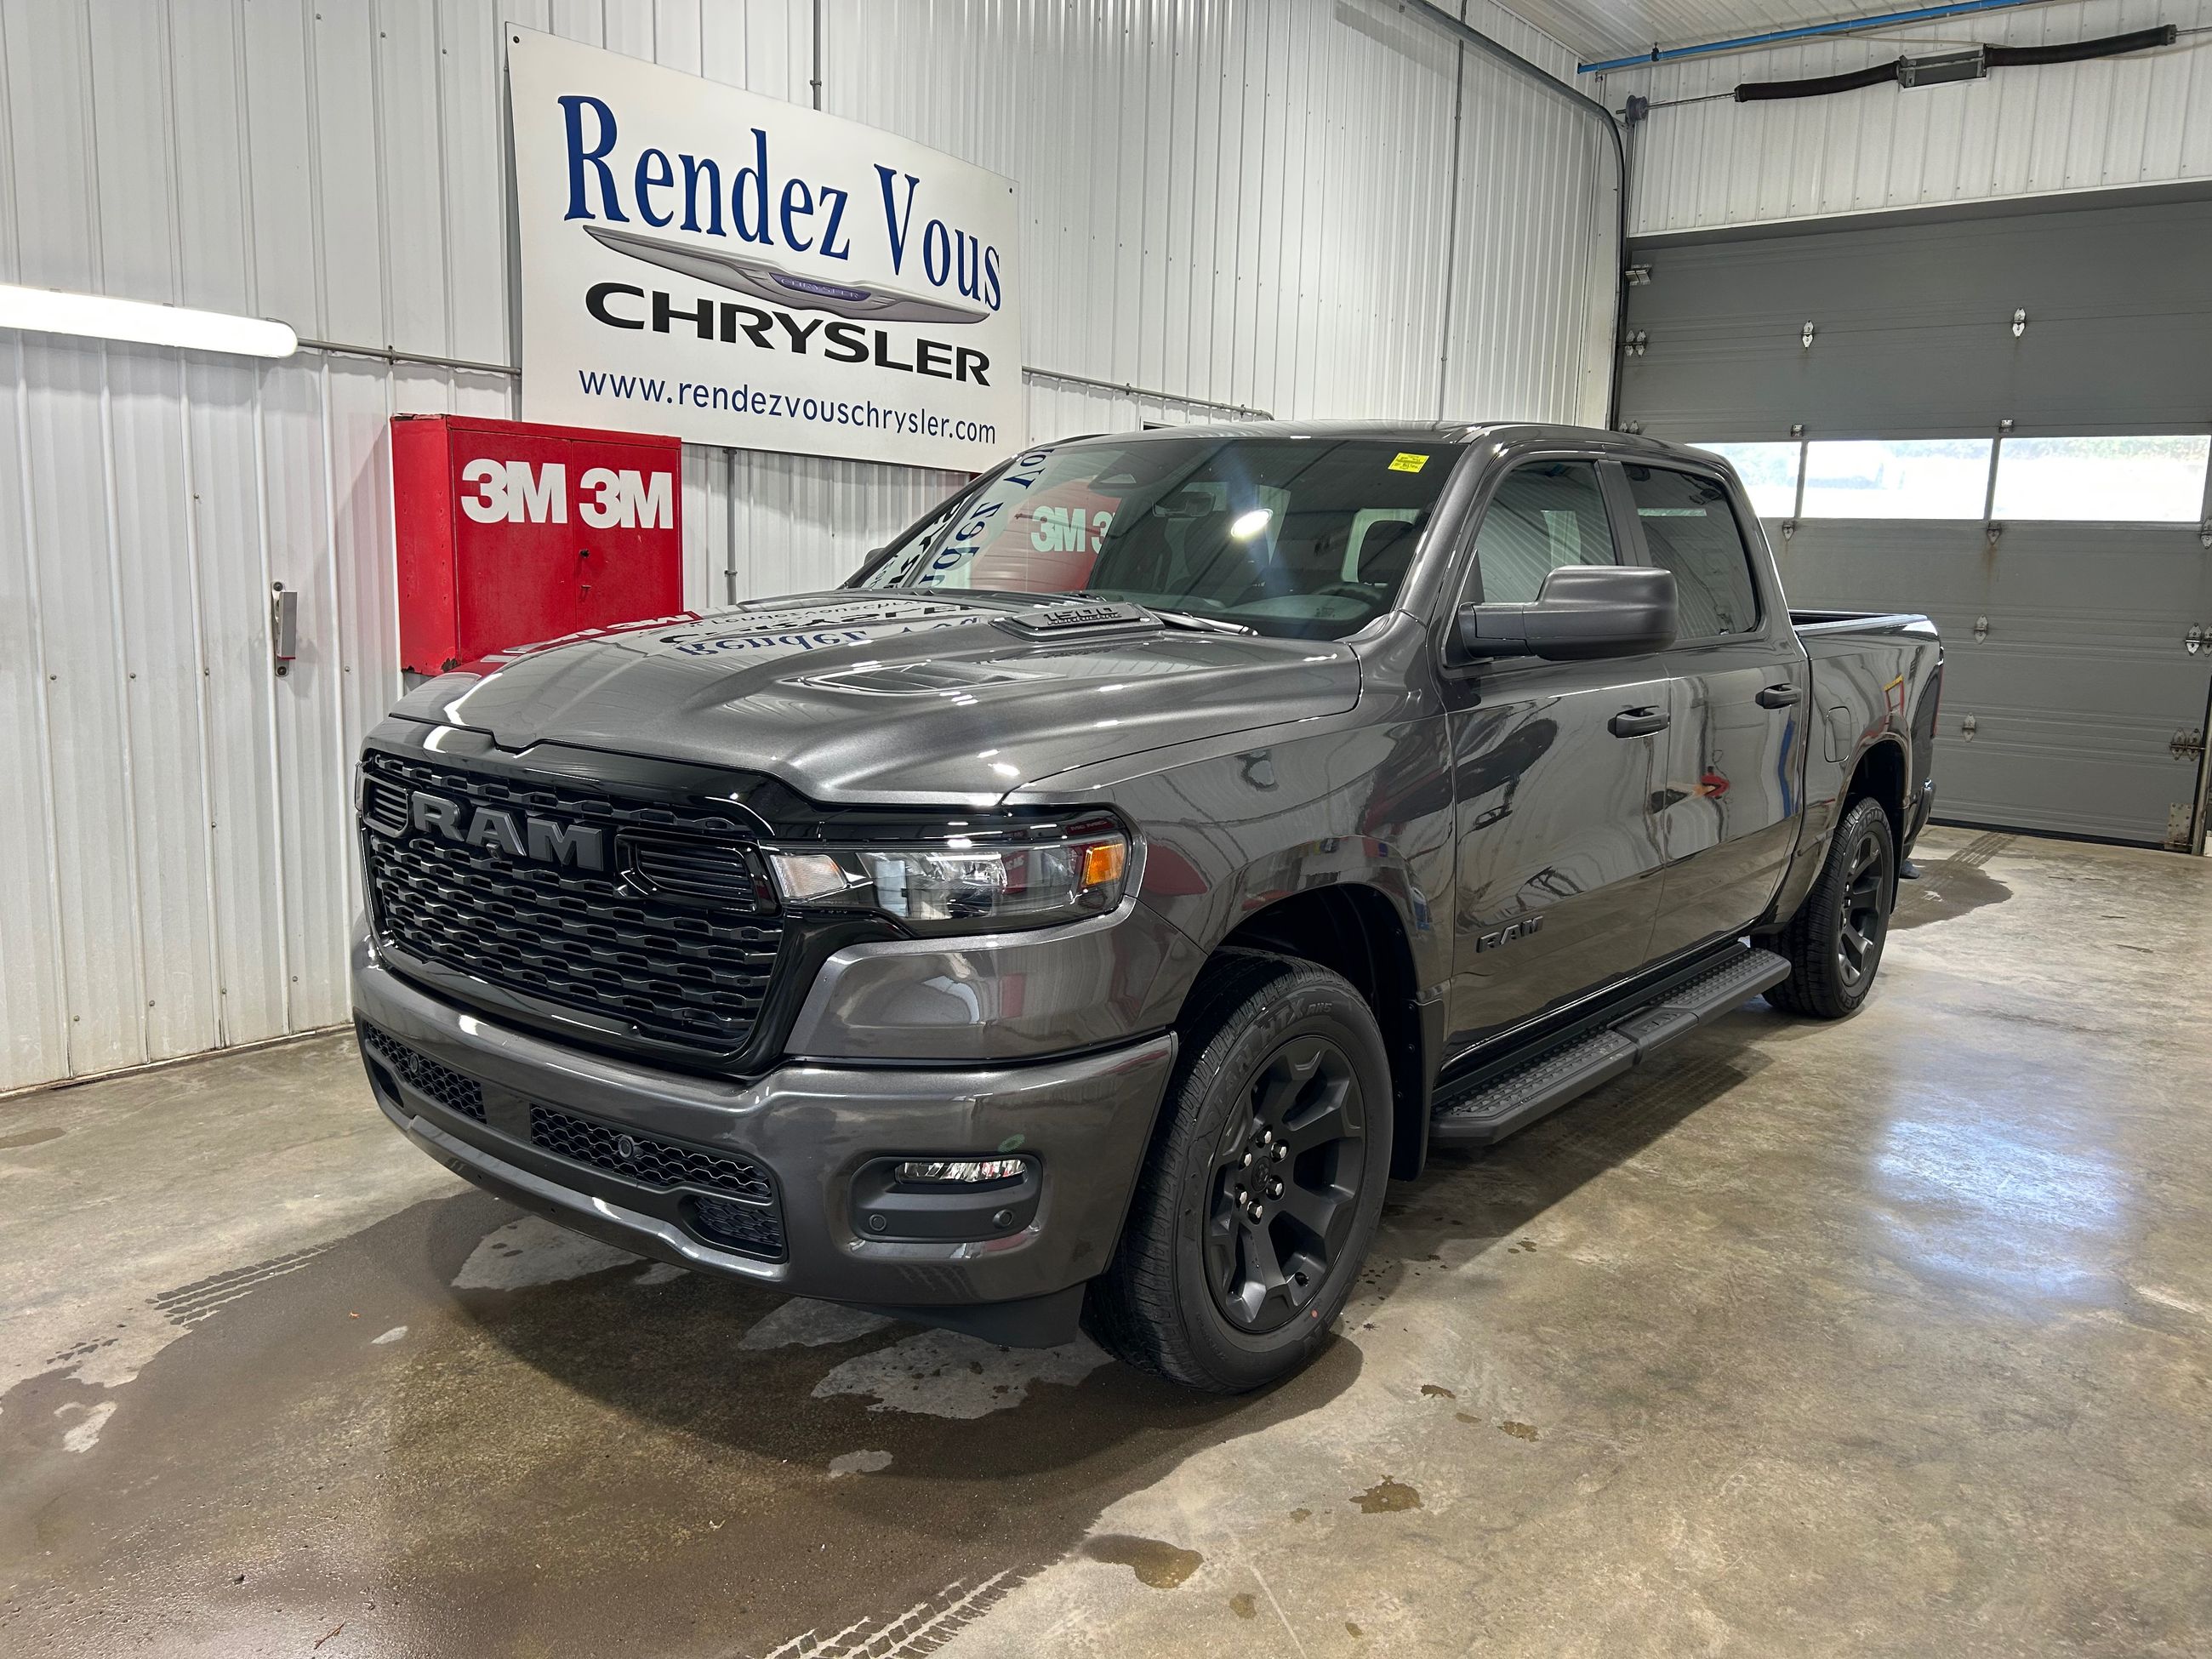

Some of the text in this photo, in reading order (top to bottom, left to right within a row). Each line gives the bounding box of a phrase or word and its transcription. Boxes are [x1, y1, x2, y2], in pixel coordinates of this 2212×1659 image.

[557, 94, 1002, 312] Rendez Vous
[585, 282, 991, 387] CHRYSLER
[579, 369, 996, 445] www.rendezvouschrysler.com
[460, 458, 674, 529] 3M 3M
[1030, 505, 1116, 554] 3M 3
[412, 790, 605, 871] RAM
[1476, 915, 1544, 953] RAM
